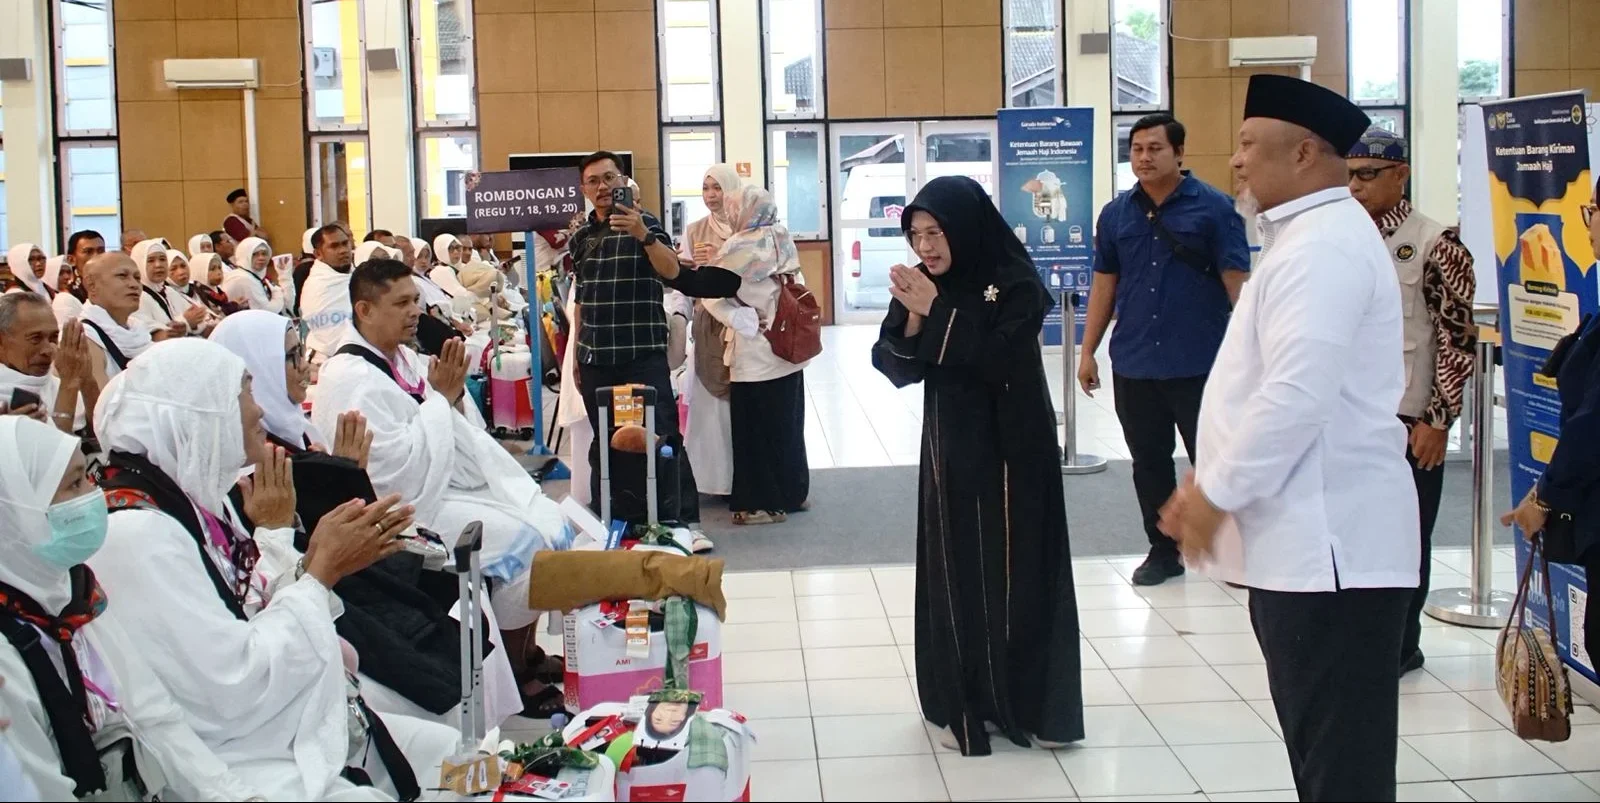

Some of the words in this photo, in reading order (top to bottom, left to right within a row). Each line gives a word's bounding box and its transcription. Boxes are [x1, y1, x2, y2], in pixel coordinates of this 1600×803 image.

[1039, 140, 1060, 148] Barang
[1495, 146, 1526, 156] Ketentuan
[1526, 145, 1549, 157] Barang
[1549, 142, 1576, 154] Kiriman
[1542, 160, 1553, 173] Haji
[474, 187, 565, 203] ROMBONGAN
[568, 186, 577, 197] 5
[474, 206, 507, 219] (REGU
[509, 206, 525, 216] 17,
[527, 204, 542, 215] 18,
[544, 204, 560, 214] 19,
[561, 203, 578, 214] 20)
